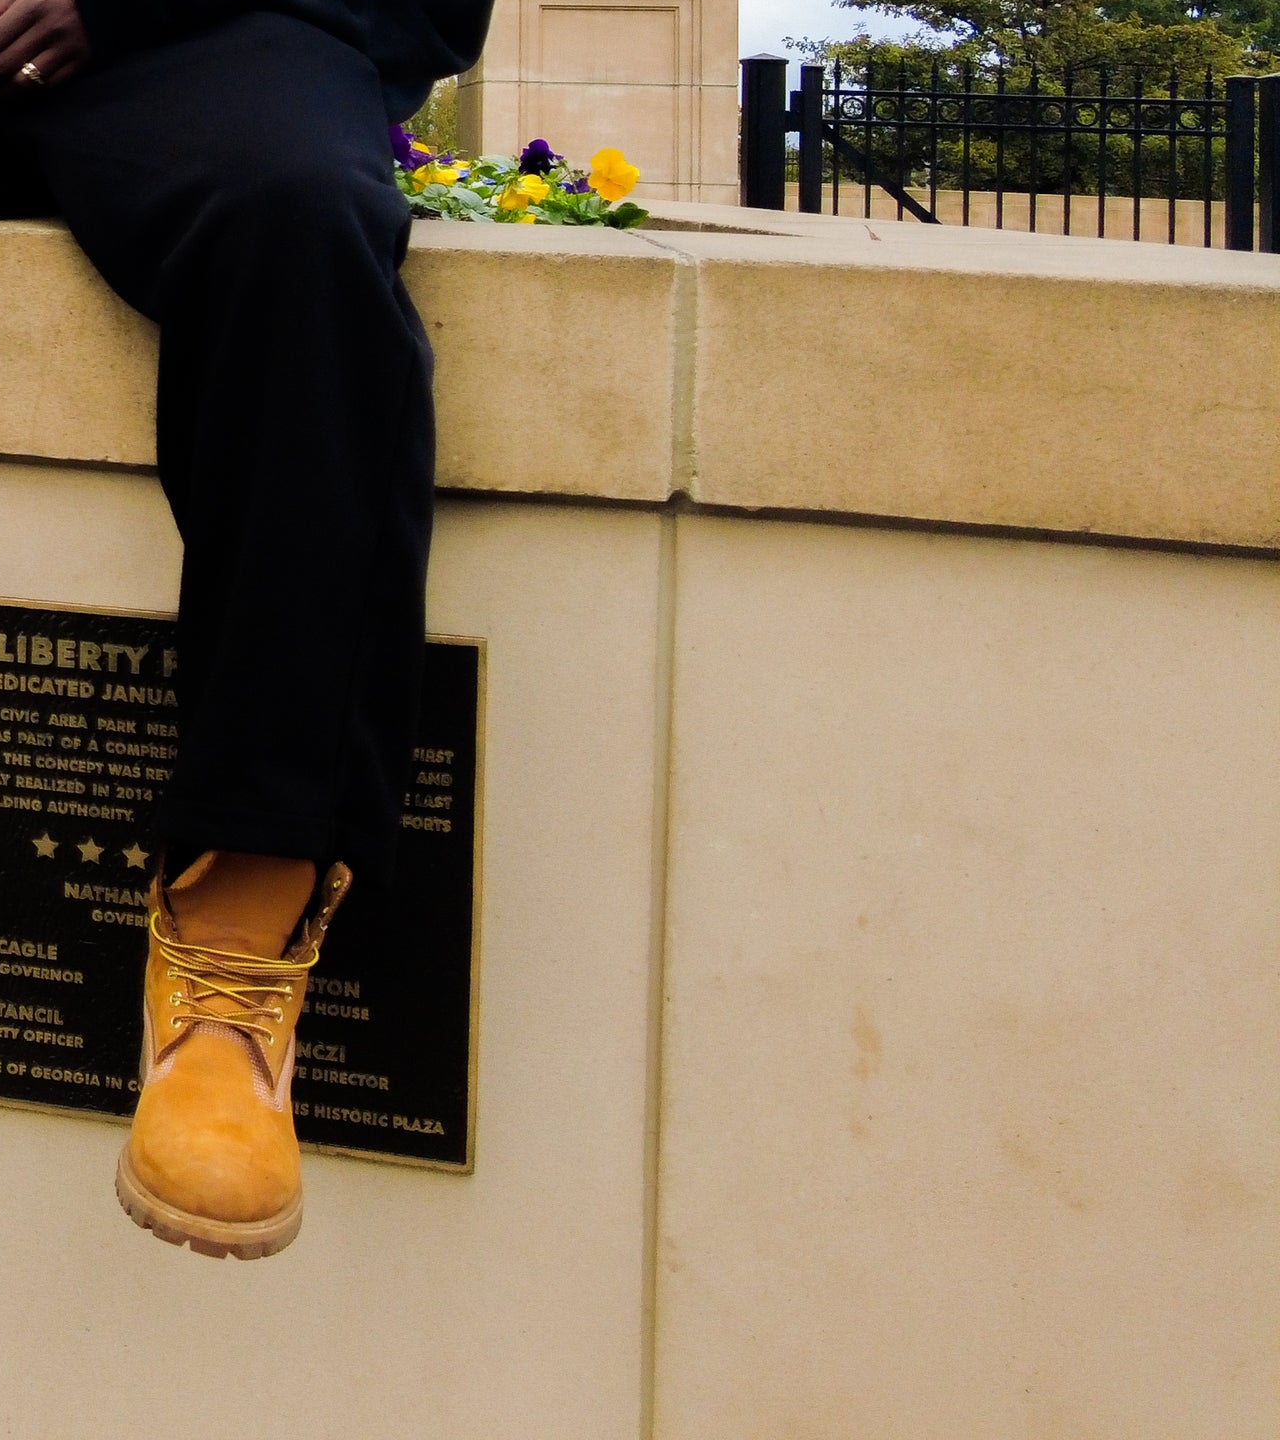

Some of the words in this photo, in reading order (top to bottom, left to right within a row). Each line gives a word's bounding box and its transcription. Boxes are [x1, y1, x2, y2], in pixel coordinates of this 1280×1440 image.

[102, 682, 180, 707] JANUA
[0, 706, 39, 724] CIVIC
[49, 711, 87, 729] AREA
[98, 716, 136, 734] PARK
[147, 721, 179, 739] NEA
[18, 730, 53, 748] PART
[61, 734, 81, 750] OF
[88, 737, 98, 752] A
[416, 771, 453, 786] AND
[3, 751, 31, 767] THE
[36, 754, 104, 775] CONCEPT
[108, 762, 140, 778] WAS
[415, 794, 453, 809] LAST
[16, 774, 85, 794] REALIZED
[93, 782, 109, 797] IN
[117, 785, 154, 802] 2014
[47, 800, 136, 823] AUTHORITY.
[63, 881, 148, 907] NATHAN
[0, 961, 85, 985] GOVERNOR
[315, 1001, 370, 1020] HOUSE
[24, 1028, 85, 1049] OFFICER
[312, 1068, 389, 1090] DIRECTOR
[7, 1061, 26, 1076] OF
[31, 1064, 100, 1087] GEORGIA
[106, 1075, 122, 1090] IN
[314, 1105, 388, 1127] HISTORIC
[393, 1115, 444, 1135] PLAZA
